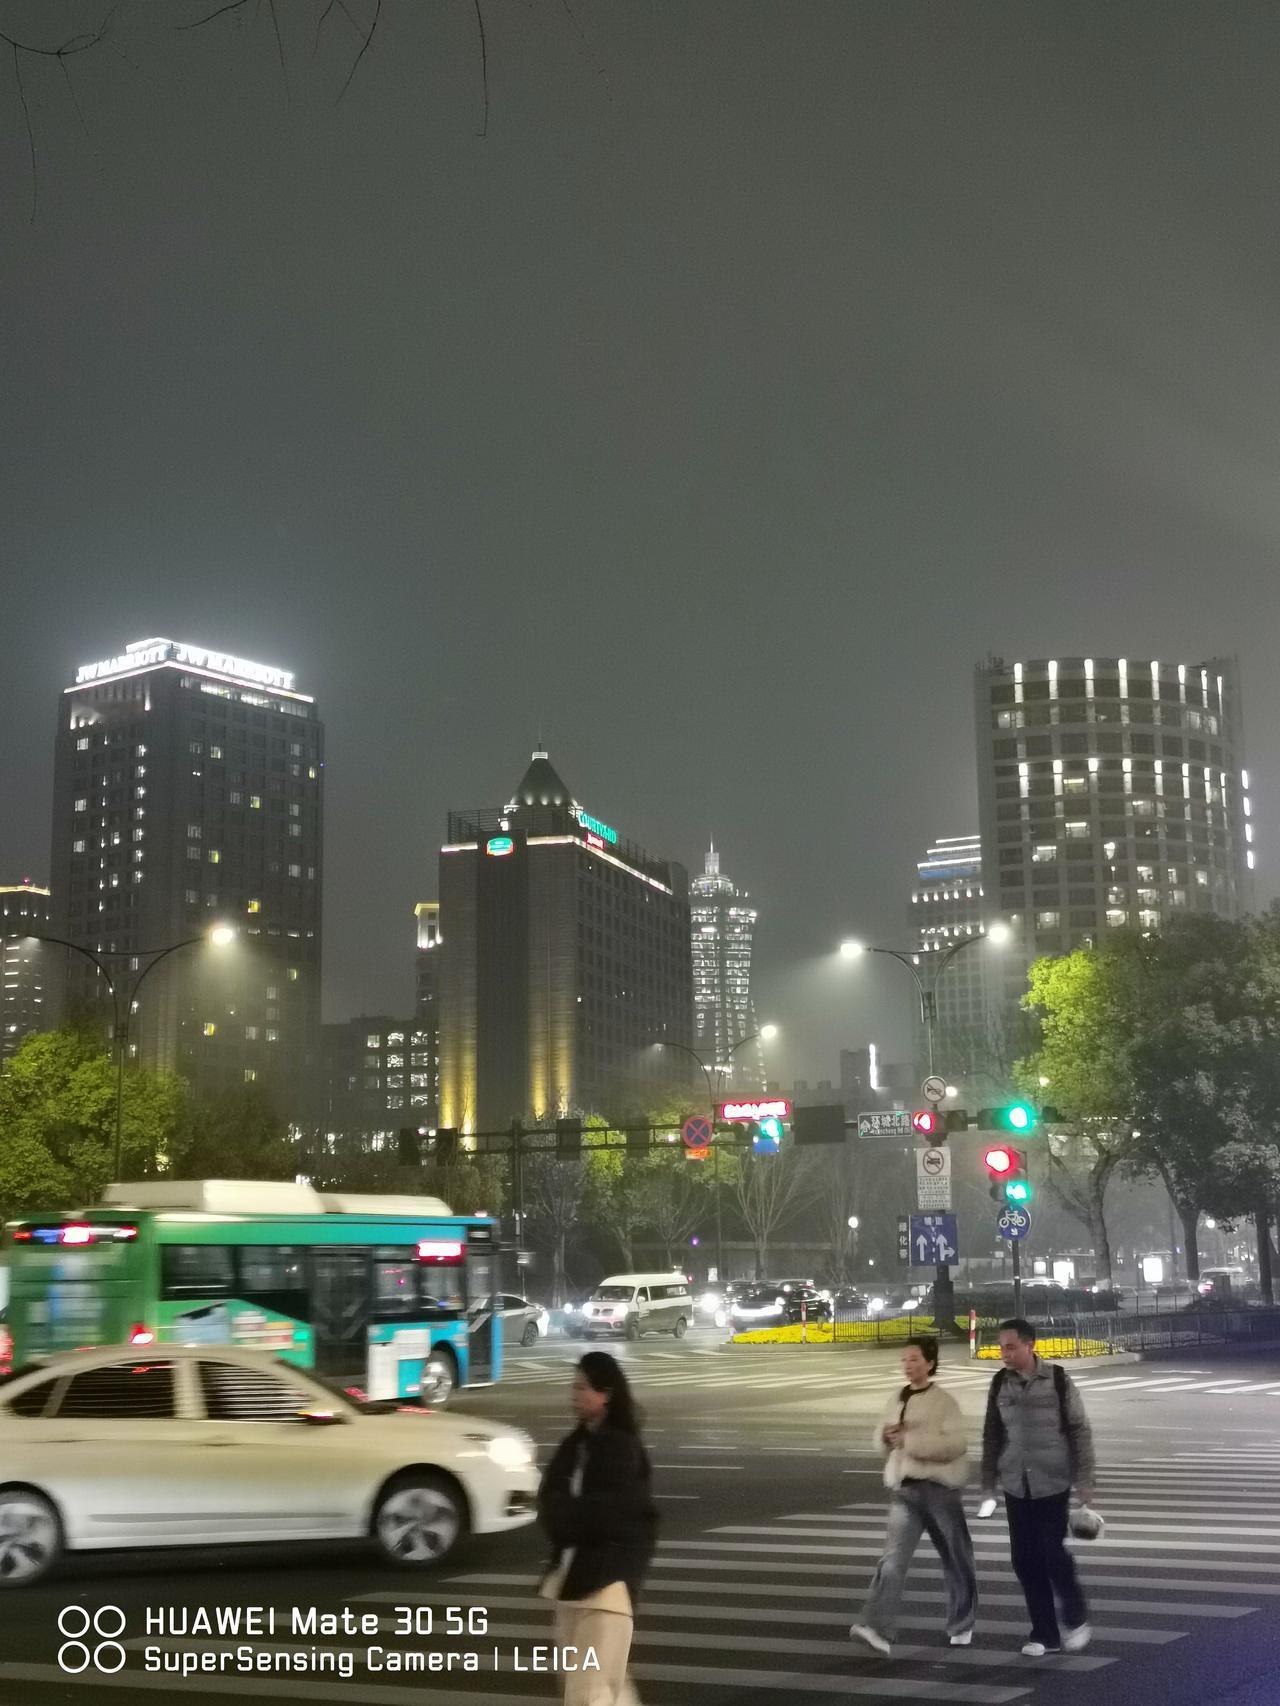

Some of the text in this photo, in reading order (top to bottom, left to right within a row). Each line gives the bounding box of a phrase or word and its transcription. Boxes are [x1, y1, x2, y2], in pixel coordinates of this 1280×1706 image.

[76, 645, 167, 683] JW MARRIOTT
[176, 644, 294, 689] JW MARRIOTT
[578, 810, 617, 844] COURTYARD
